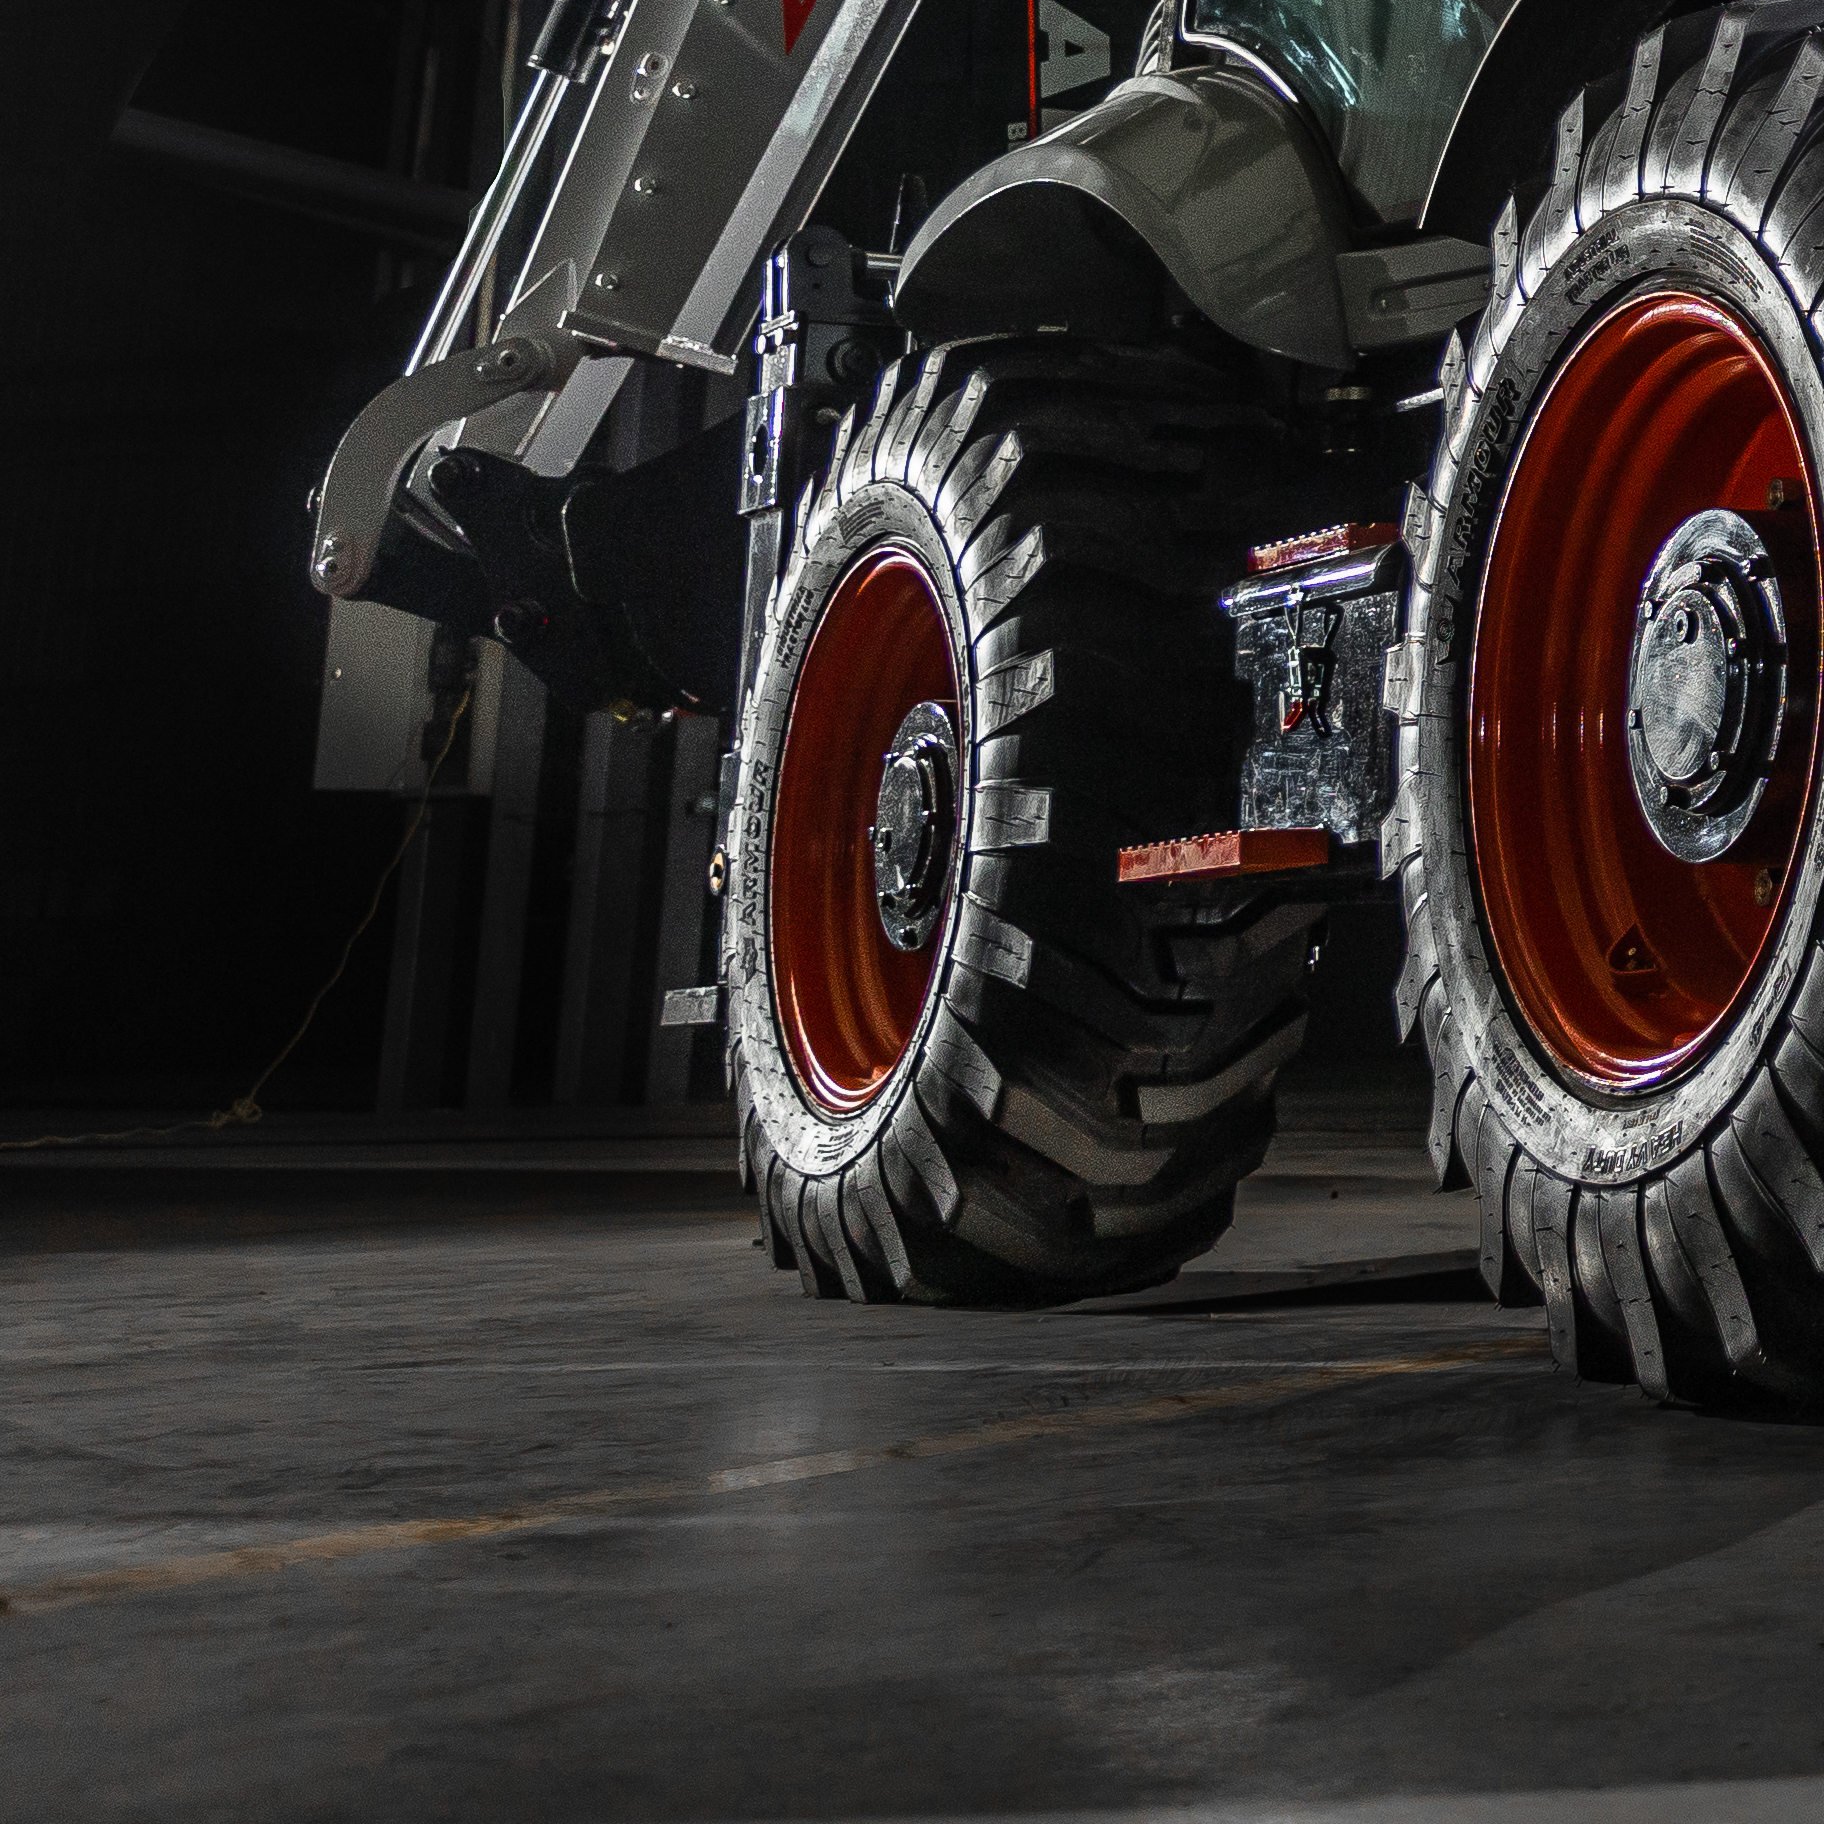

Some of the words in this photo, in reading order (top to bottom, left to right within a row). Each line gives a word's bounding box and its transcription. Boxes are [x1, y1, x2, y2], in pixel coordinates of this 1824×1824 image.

[1446, 376, 1520, 588] ARMOUR
[740, 760, 771, 928] ARMOUR
[1580, 1143, 1627, 1175] DUTY
[1626, 1119, 1683, 1170] HEAVY
